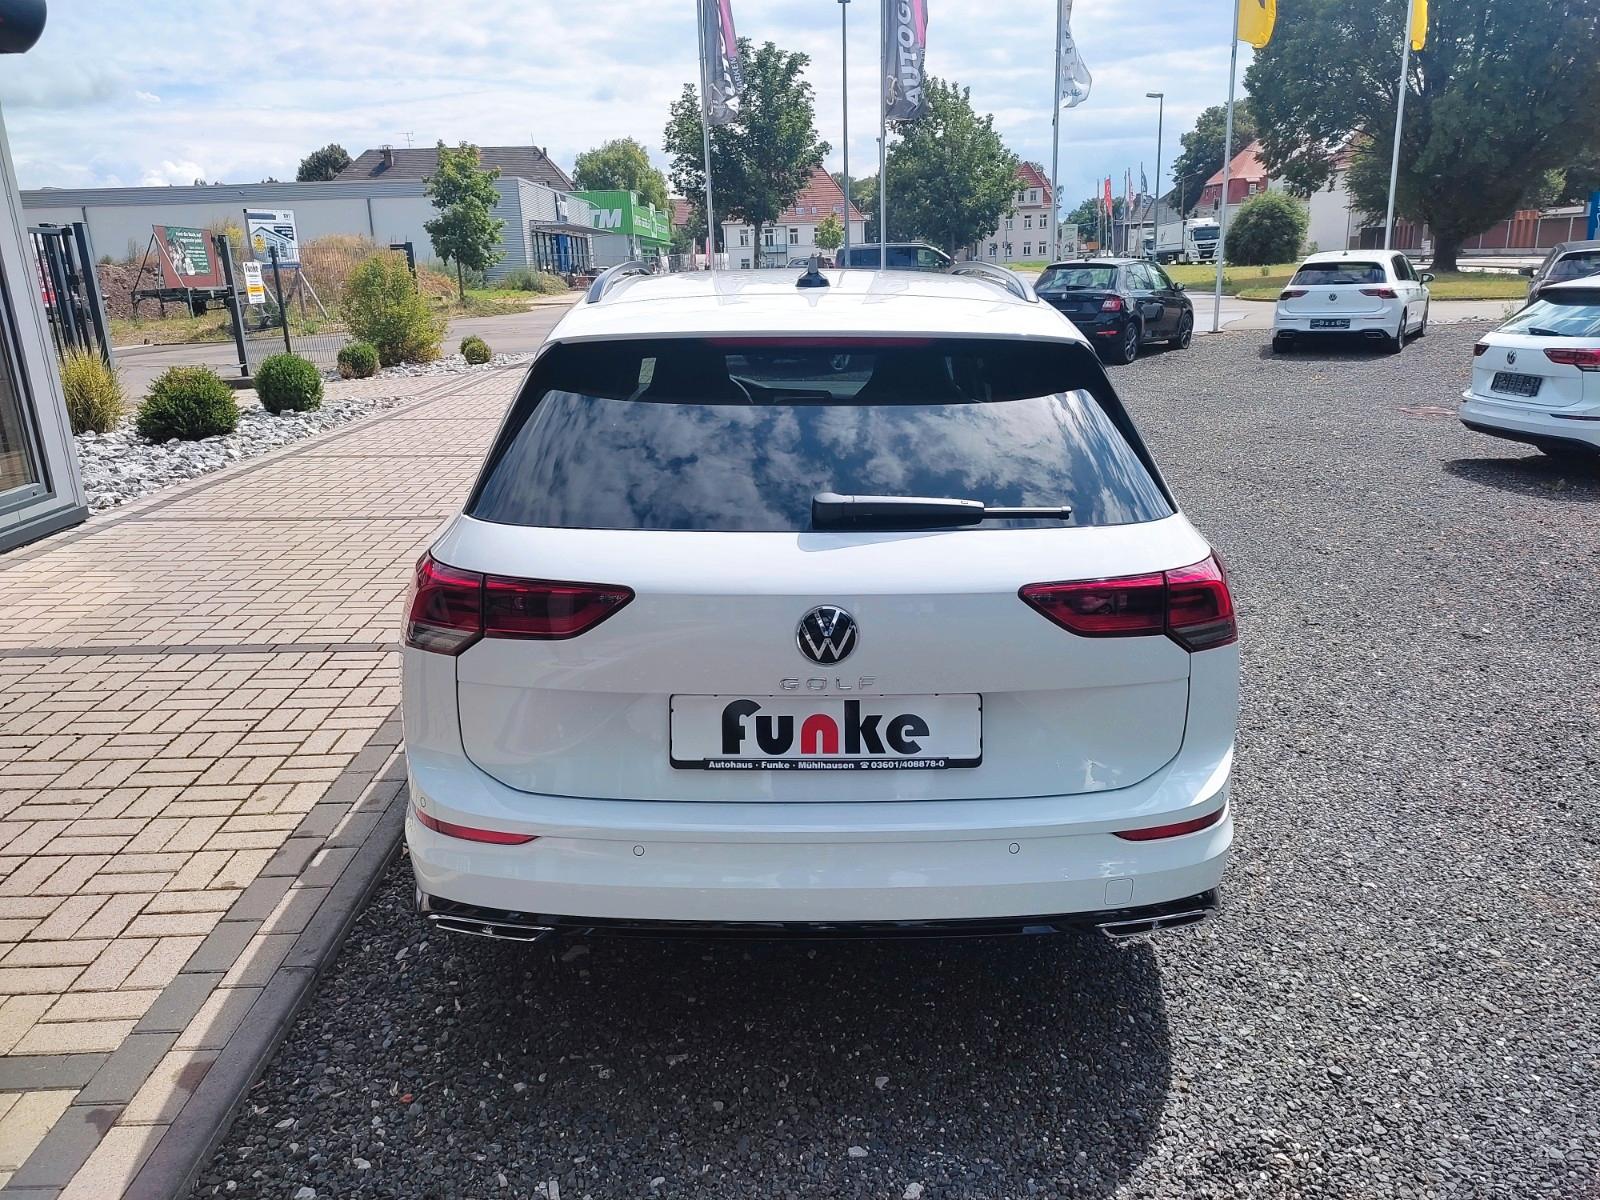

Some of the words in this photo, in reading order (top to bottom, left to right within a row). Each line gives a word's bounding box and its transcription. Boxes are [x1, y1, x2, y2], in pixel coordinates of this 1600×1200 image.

[897, 0, 922, 108] AUTOG
[797, 605, 859, 665] VW
[778, 676, 877, 690] GOLF
[721, 699, 930, 755] funke
[708, 760, 754, 770] Autohaus
[761, 760, 790, 770] Funke
[797, 760, 855, 770] Mühlhausen
